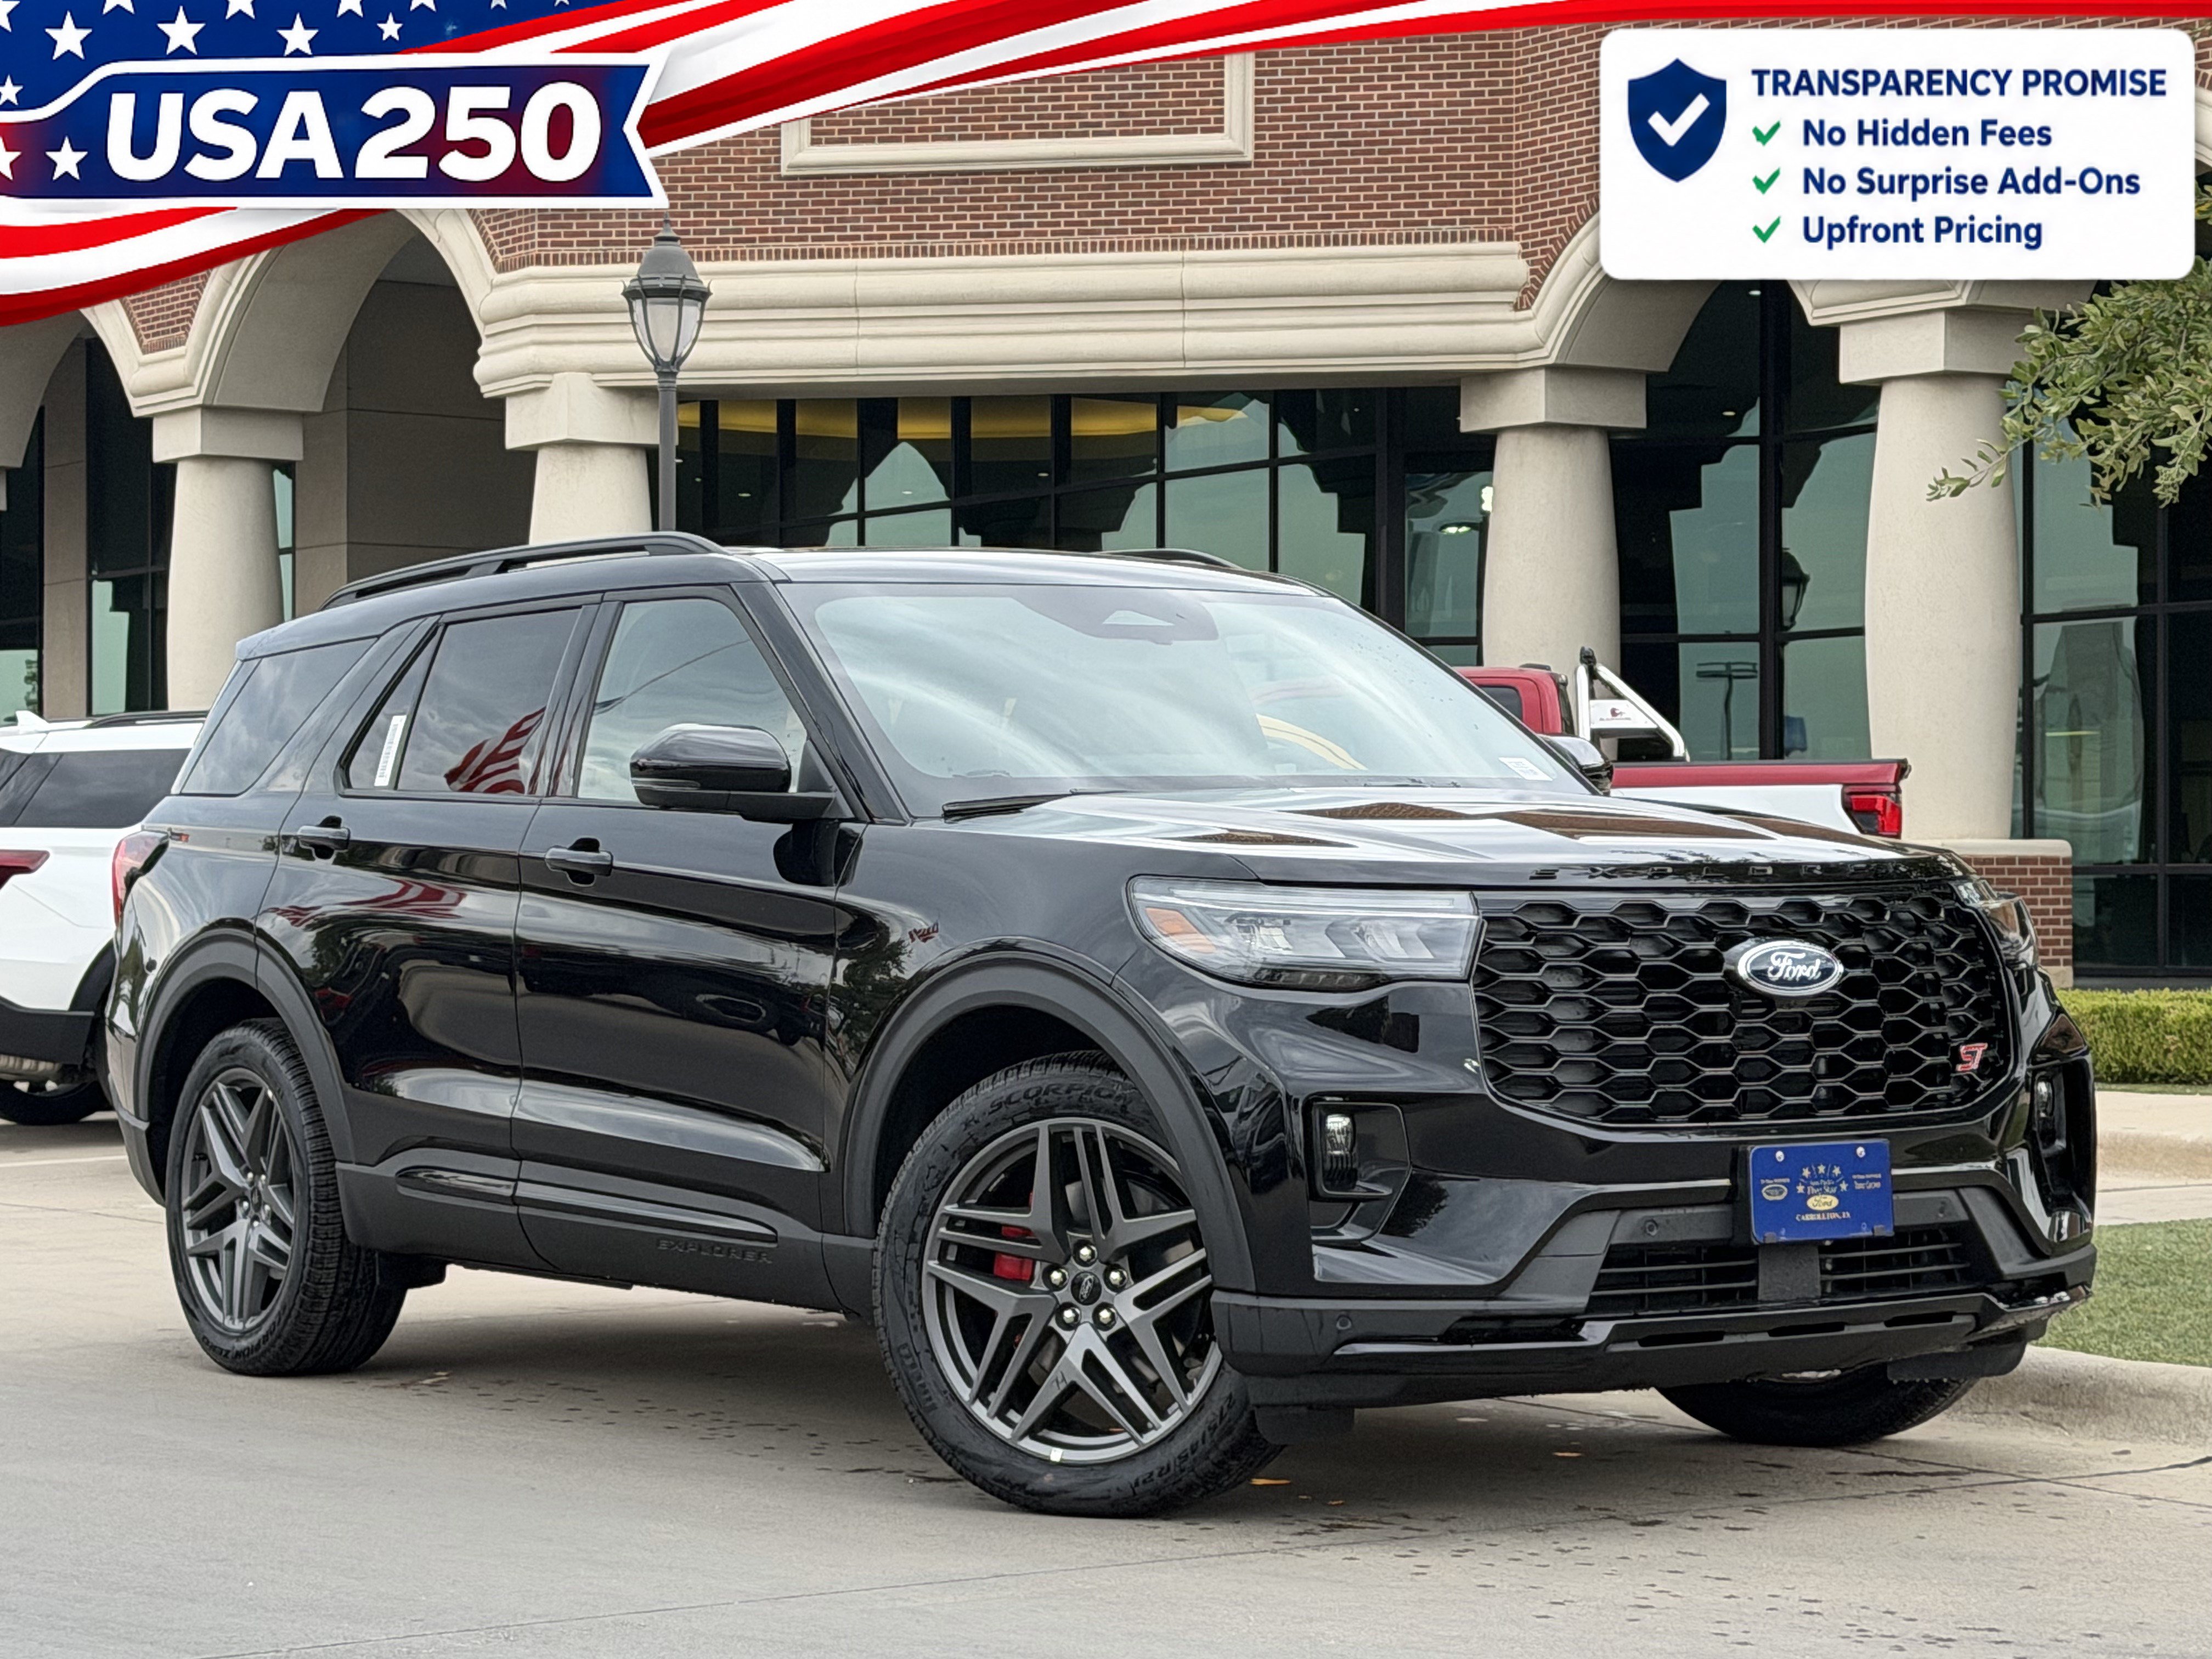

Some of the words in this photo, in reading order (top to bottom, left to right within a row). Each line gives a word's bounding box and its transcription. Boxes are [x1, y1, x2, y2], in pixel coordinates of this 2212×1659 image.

[1767, 951, 1821, 981] Ford
[1956, 1042, 1988, 1072] ST
[657, 1239, 772, 1263] EXPLORER
